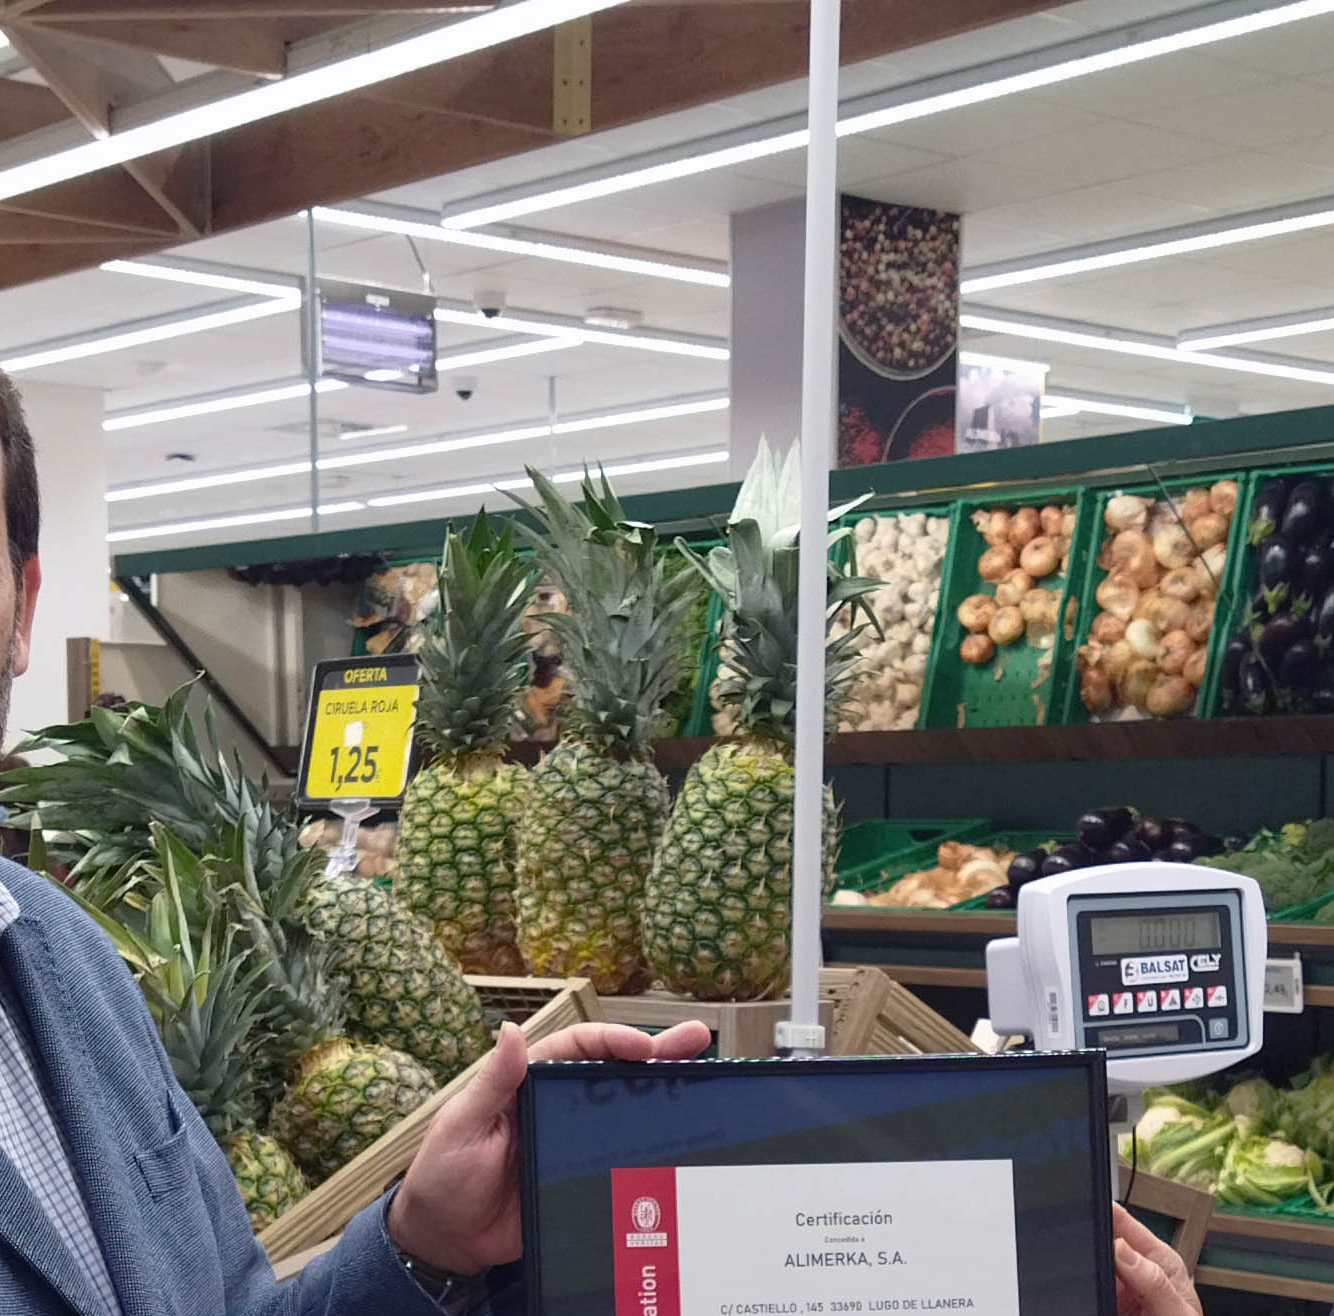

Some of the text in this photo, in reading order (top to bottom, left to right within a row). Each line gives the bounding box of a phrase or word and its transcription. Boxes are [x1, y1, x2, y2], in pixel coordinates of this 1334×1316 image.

[344, 667, 387, 684] OFERTA
[325, 699, 399, 715] CIRUELA ROJA
[330, 746, 379, 791] 1,25
[1140, 959, 1186, 974] BALSAT
[795, 1209, 893, 1227] Certificación
[784, 1251, 907, 1268] ALIMERKA, S.A.
[806, 1302, 824, 1312] 145
[868, 1300, 900, 1311] LUGO
[902, 1300, 918, 1310] DE
[921, 1298, 974, 1310] LLANERA
